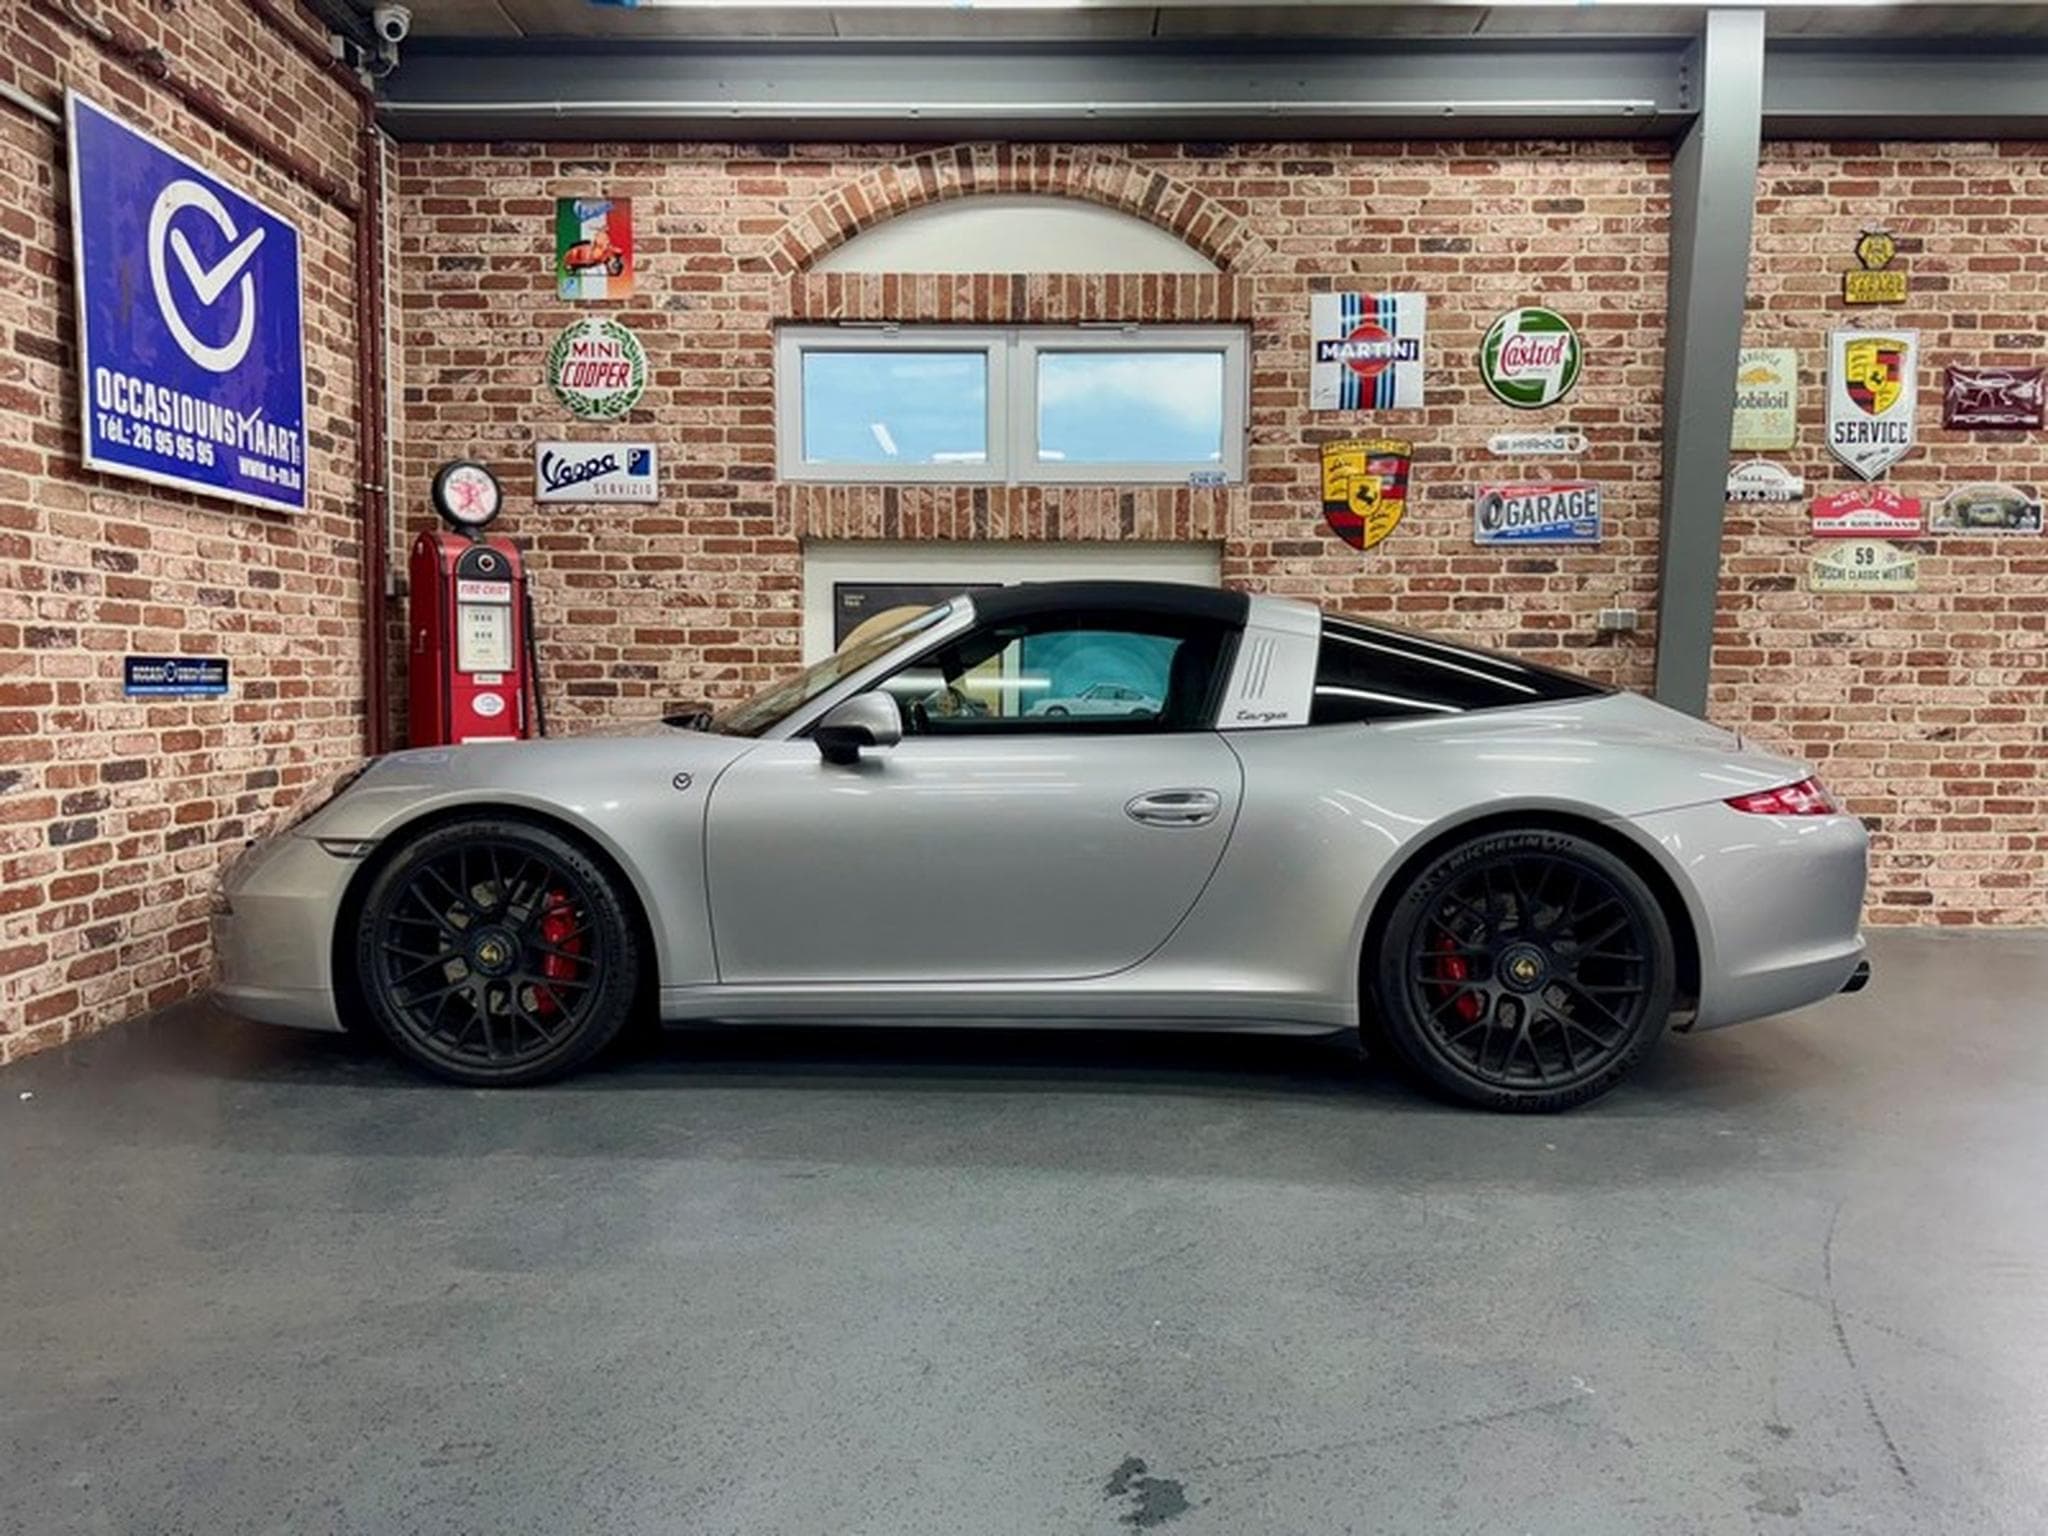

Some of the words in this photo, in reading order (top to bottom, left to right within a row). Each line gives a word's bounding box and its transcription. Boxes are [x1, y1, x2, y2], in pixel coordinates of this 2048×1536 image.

[572, 342, 620, 358] MINI
[1320, 342, 1416, 359] MARTINI
[1500, 334, 1567, 376] Castrol
[562, 361, 631, 388] COOPER
[132, 421, 152, 451] 26
[155, 428, 175, 456] 95
[176, 434, 196, 462] 95
[197, 440, 215, 468] 95
[1834, 421, 1909, 444] SERVICE
[540, 450, 620, 493] Vespa
[1505, 488, 1597, 527] GARAGE
[1855, 547, 1875, 566] 59
